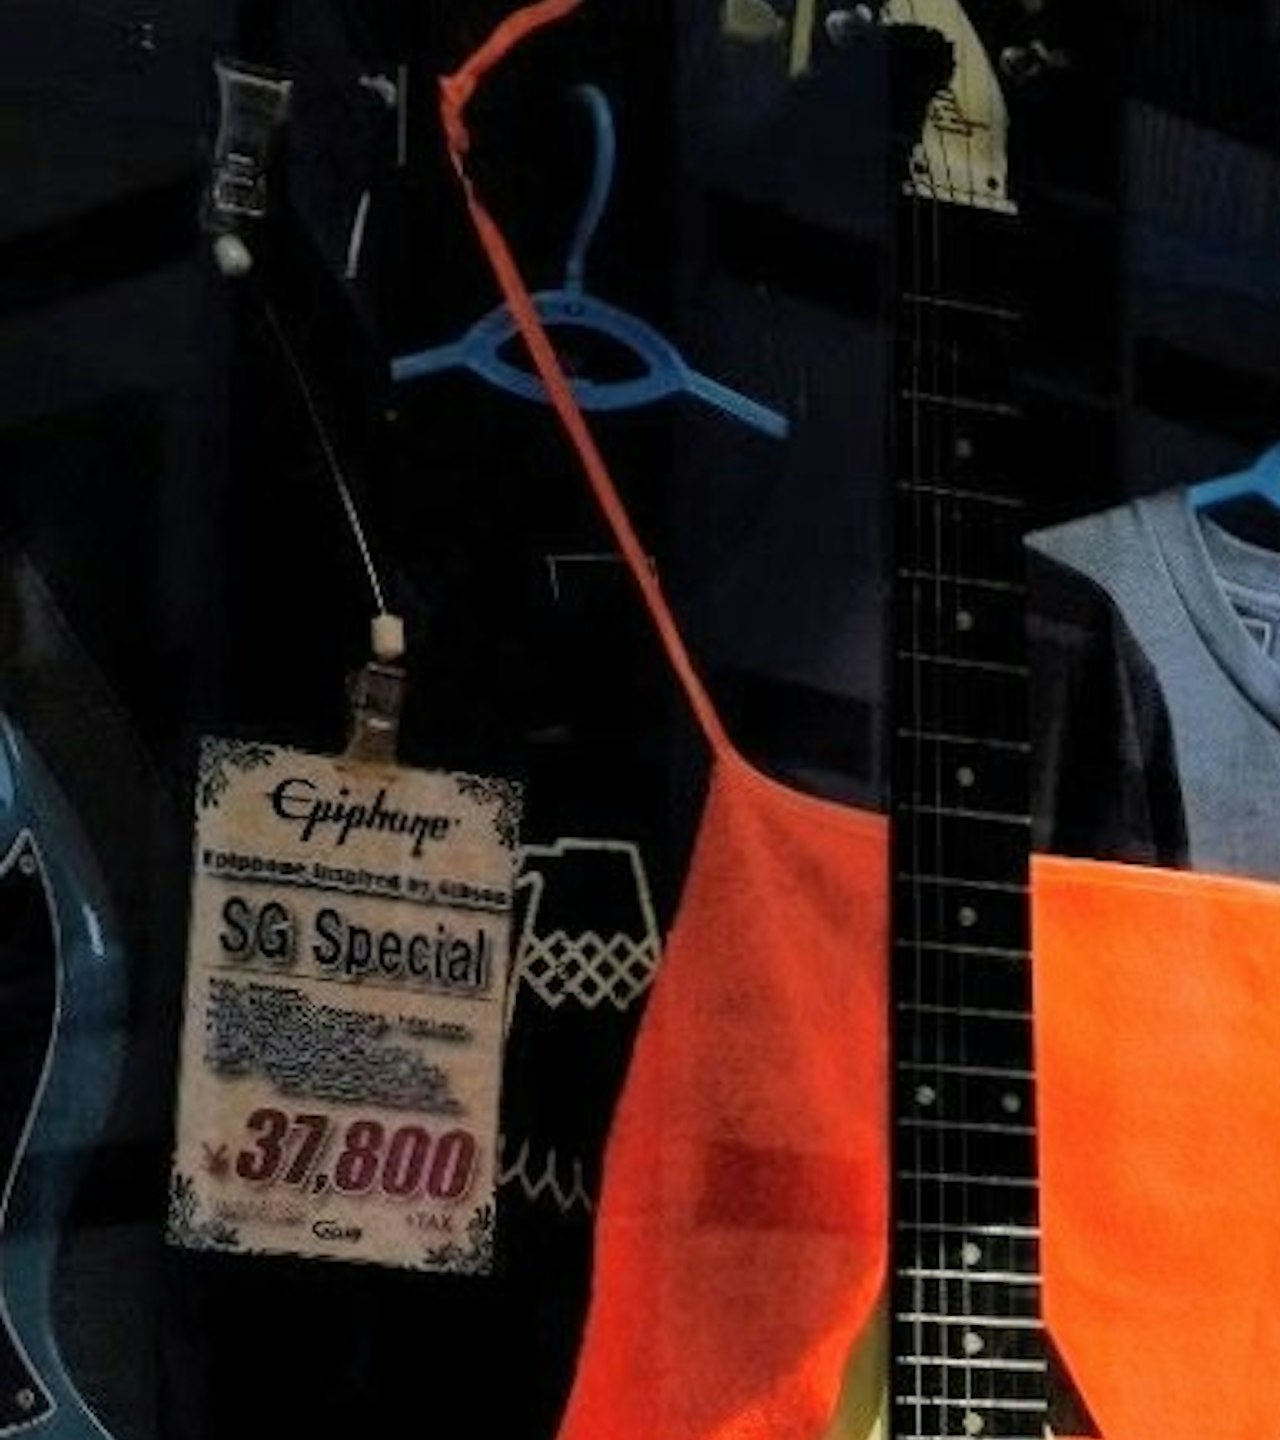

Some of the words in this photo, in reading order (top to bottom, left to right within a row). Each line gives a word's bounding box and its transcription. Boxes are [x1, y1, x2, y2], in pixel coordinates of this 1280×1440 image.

[265, 778, 451, 858] Epiphone
[219, 896, 292, 958] SG
[312, 908, 485, 986] Special
